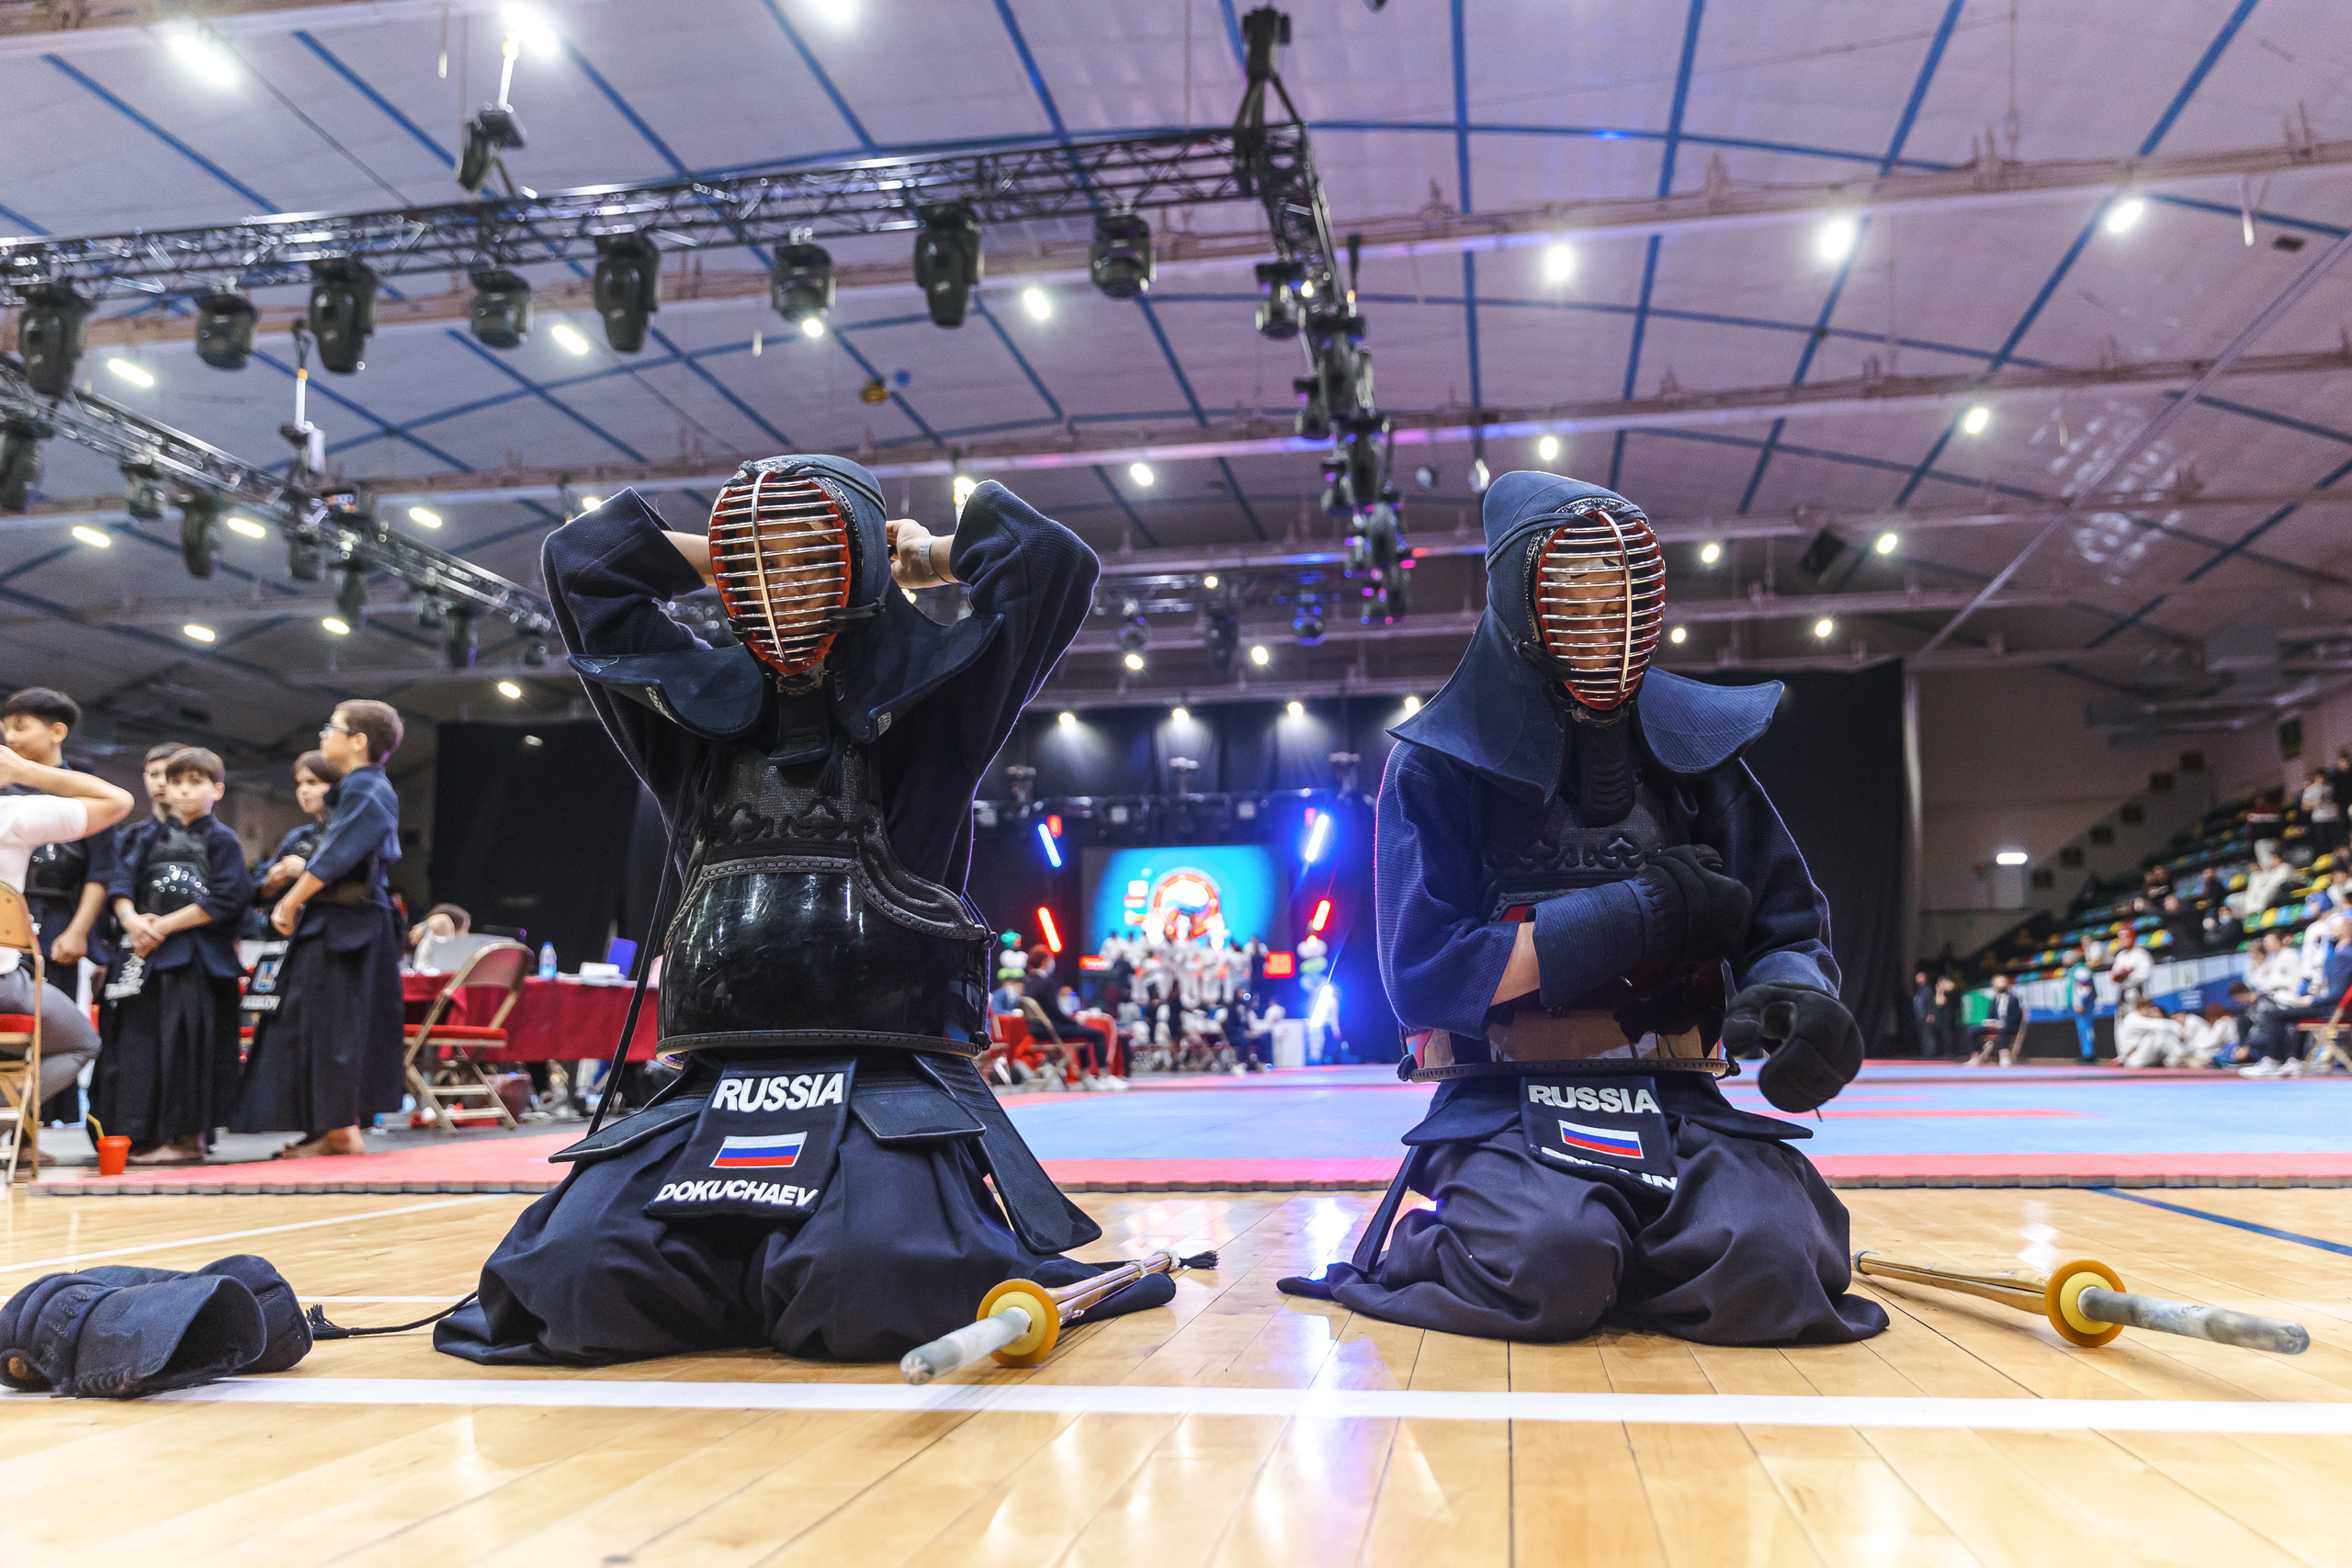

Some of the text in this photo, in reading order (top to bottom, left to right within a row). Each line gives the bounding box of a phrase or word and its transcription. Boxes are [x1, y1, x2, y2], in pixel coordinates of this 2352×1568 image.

[711, 1073, 845, 1112] RUSSIA
[1527, 1084, 1662, 1114] RUSSIA
[653, 1179, 819, 1206] DOKUCHAEV
